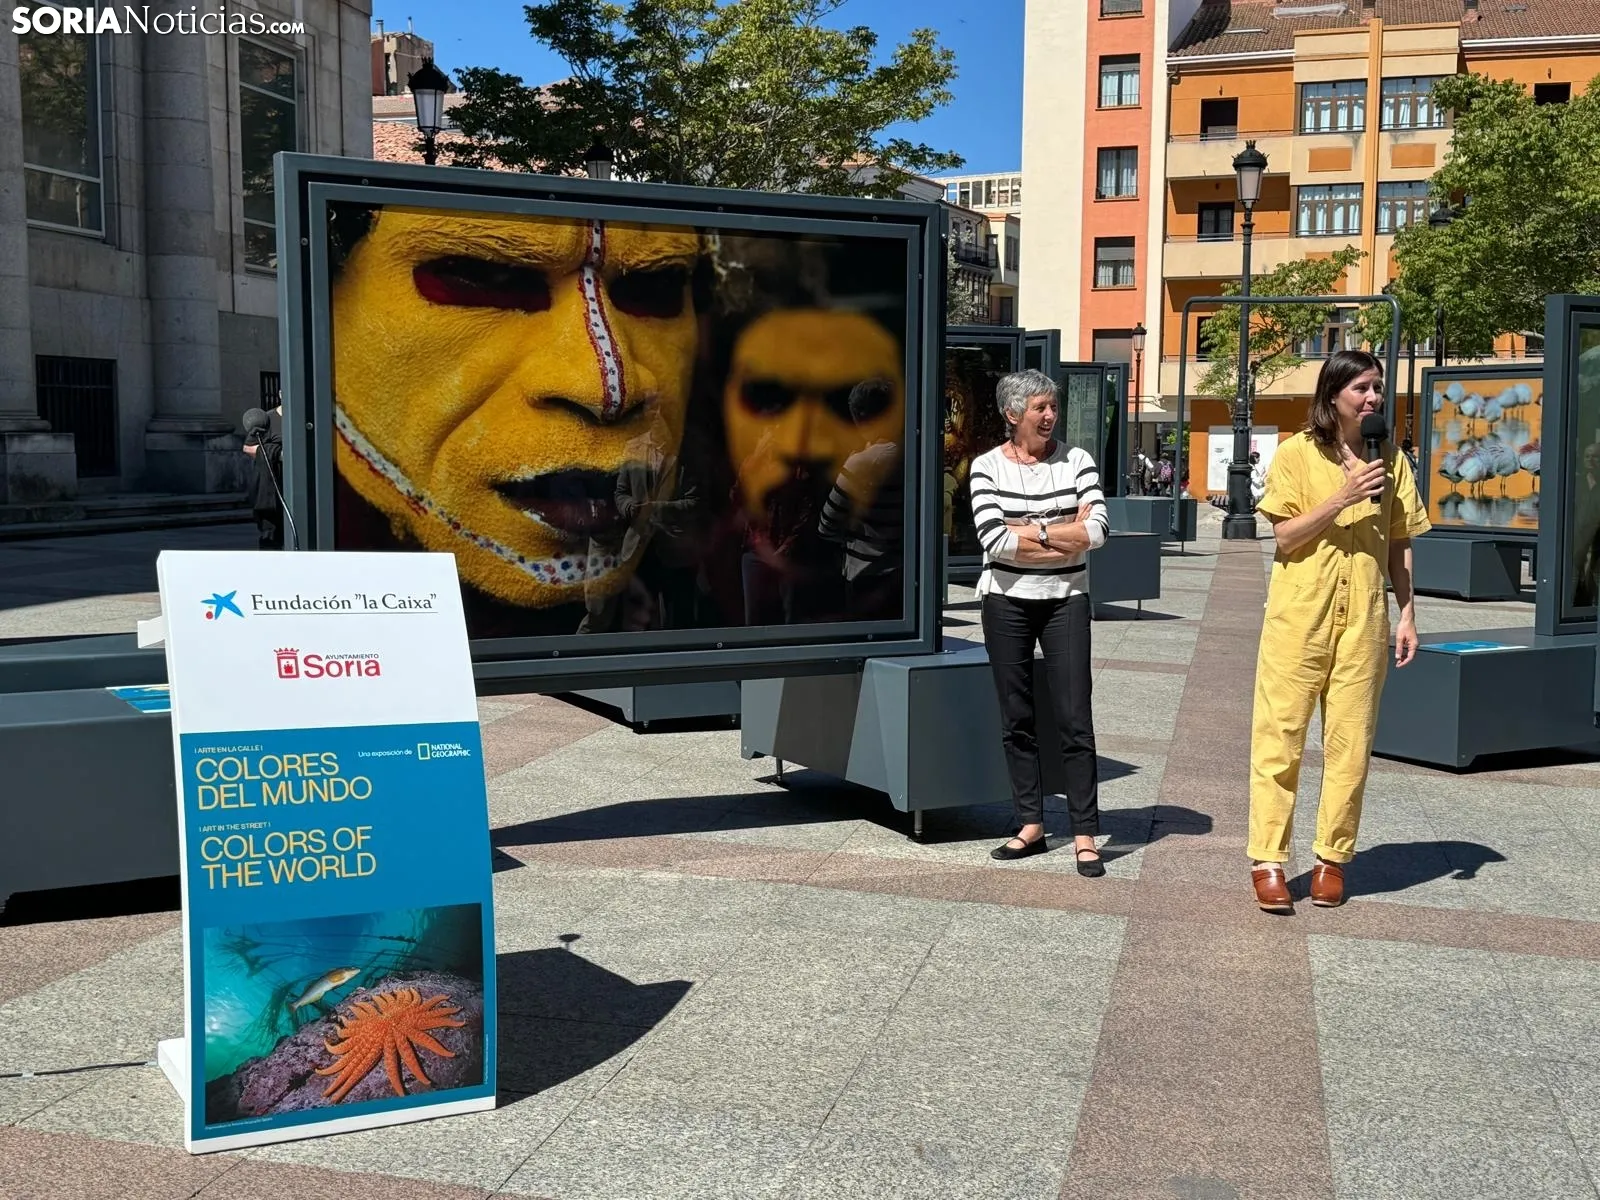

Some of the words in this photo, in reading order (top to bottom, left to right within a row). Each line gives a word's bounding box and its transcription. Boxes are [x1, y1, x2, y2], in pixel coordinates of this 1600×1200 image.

[251, 593, 351, 610] Fundación
[304, 654, 381, 678] Soria
[371, 749, 404, 758] exposición
[431, 749, 472, 758] GEOGRAPHIC
[195, 752, 339, 783] COLORES
[198, 783, 256, 810] DEL
[262, 776, 372, 806] MUNDO
[240, 821, 267, 830] STREET
[201, 828, 327, 862] COLORS
[333, 825, 373, 851] OF
[201, 861, 263, 889] THE
[269, 852, 377, 885] WORLD
